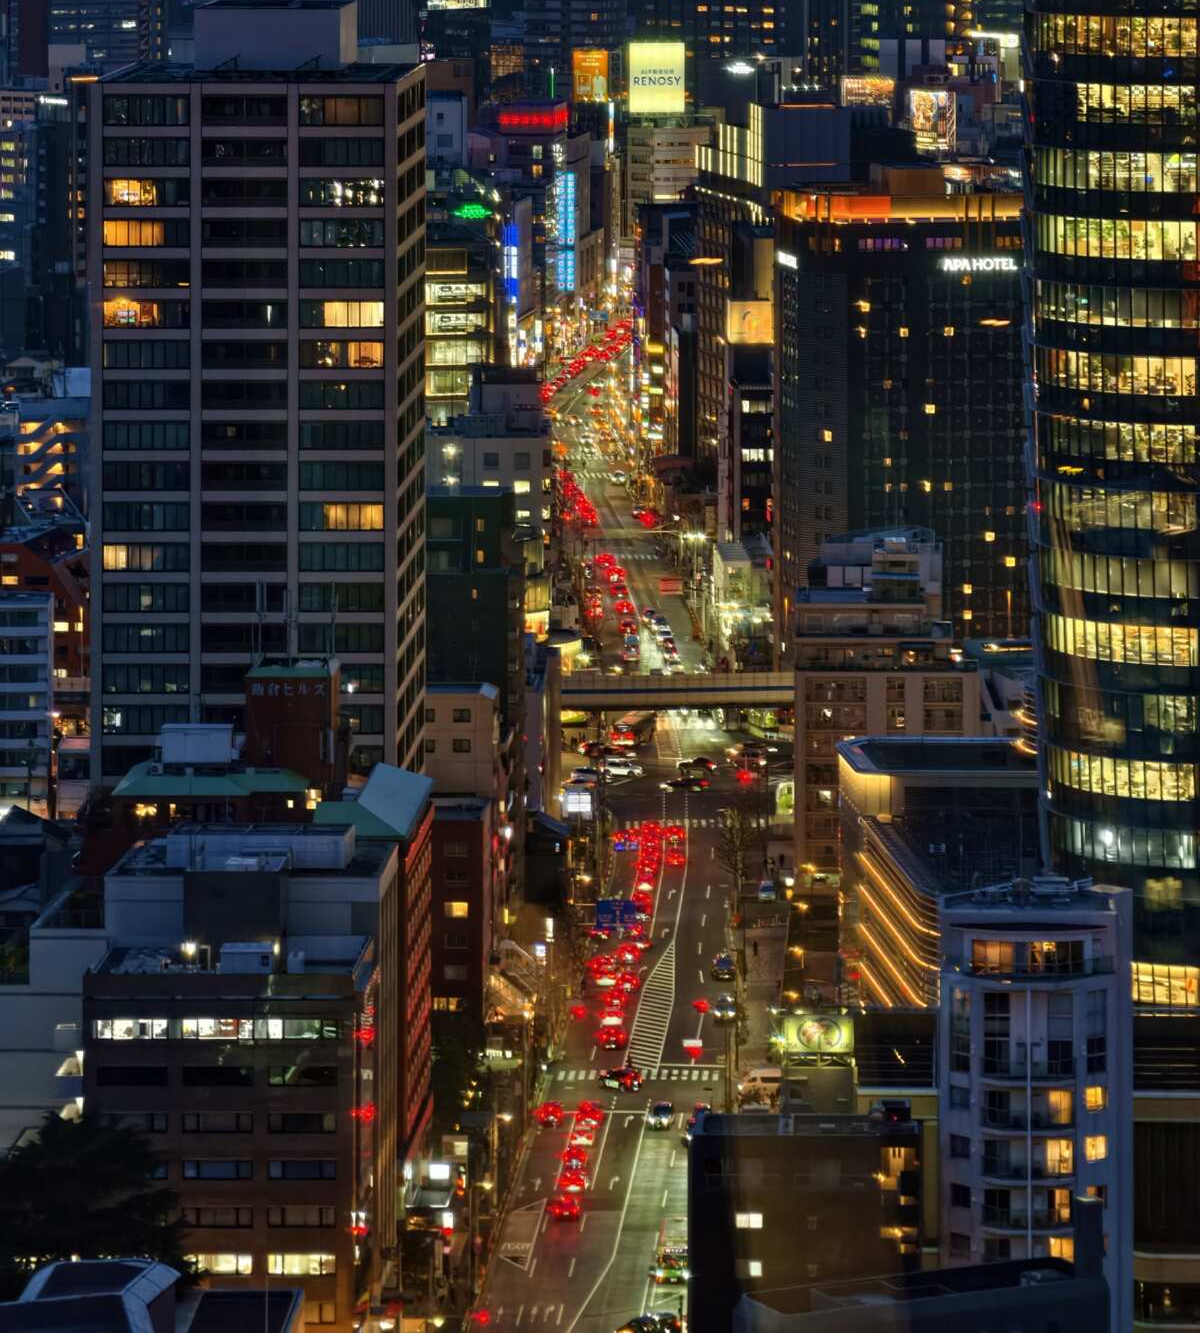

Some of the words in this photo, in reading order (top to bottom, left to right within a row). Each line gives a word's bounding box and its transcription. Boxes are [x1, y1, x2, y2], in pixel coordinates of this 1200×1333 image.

[633, 76, 681, 86] RENOSY
[943, 257, 971, 271] APA
[972, 257, 1018, 271] HOTEL
